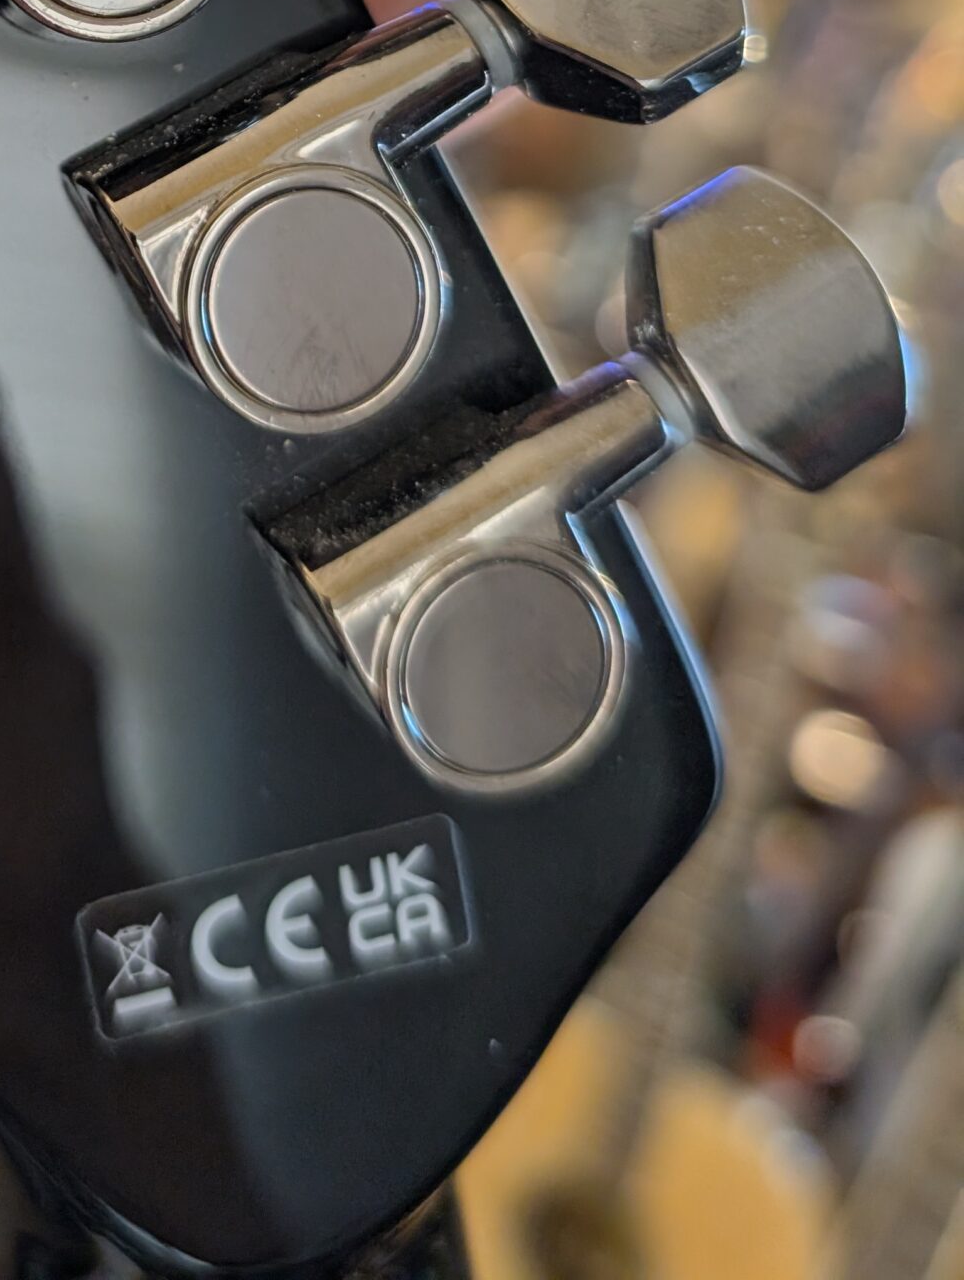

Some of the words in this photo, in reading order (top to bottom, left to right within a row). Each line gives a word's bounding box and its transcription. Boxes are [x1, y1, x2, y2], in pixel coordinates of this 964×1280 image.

[339, 842, 438, 906] UK
[190, 874, 329, 985] CE
[348, 893, 447, 954] CA
